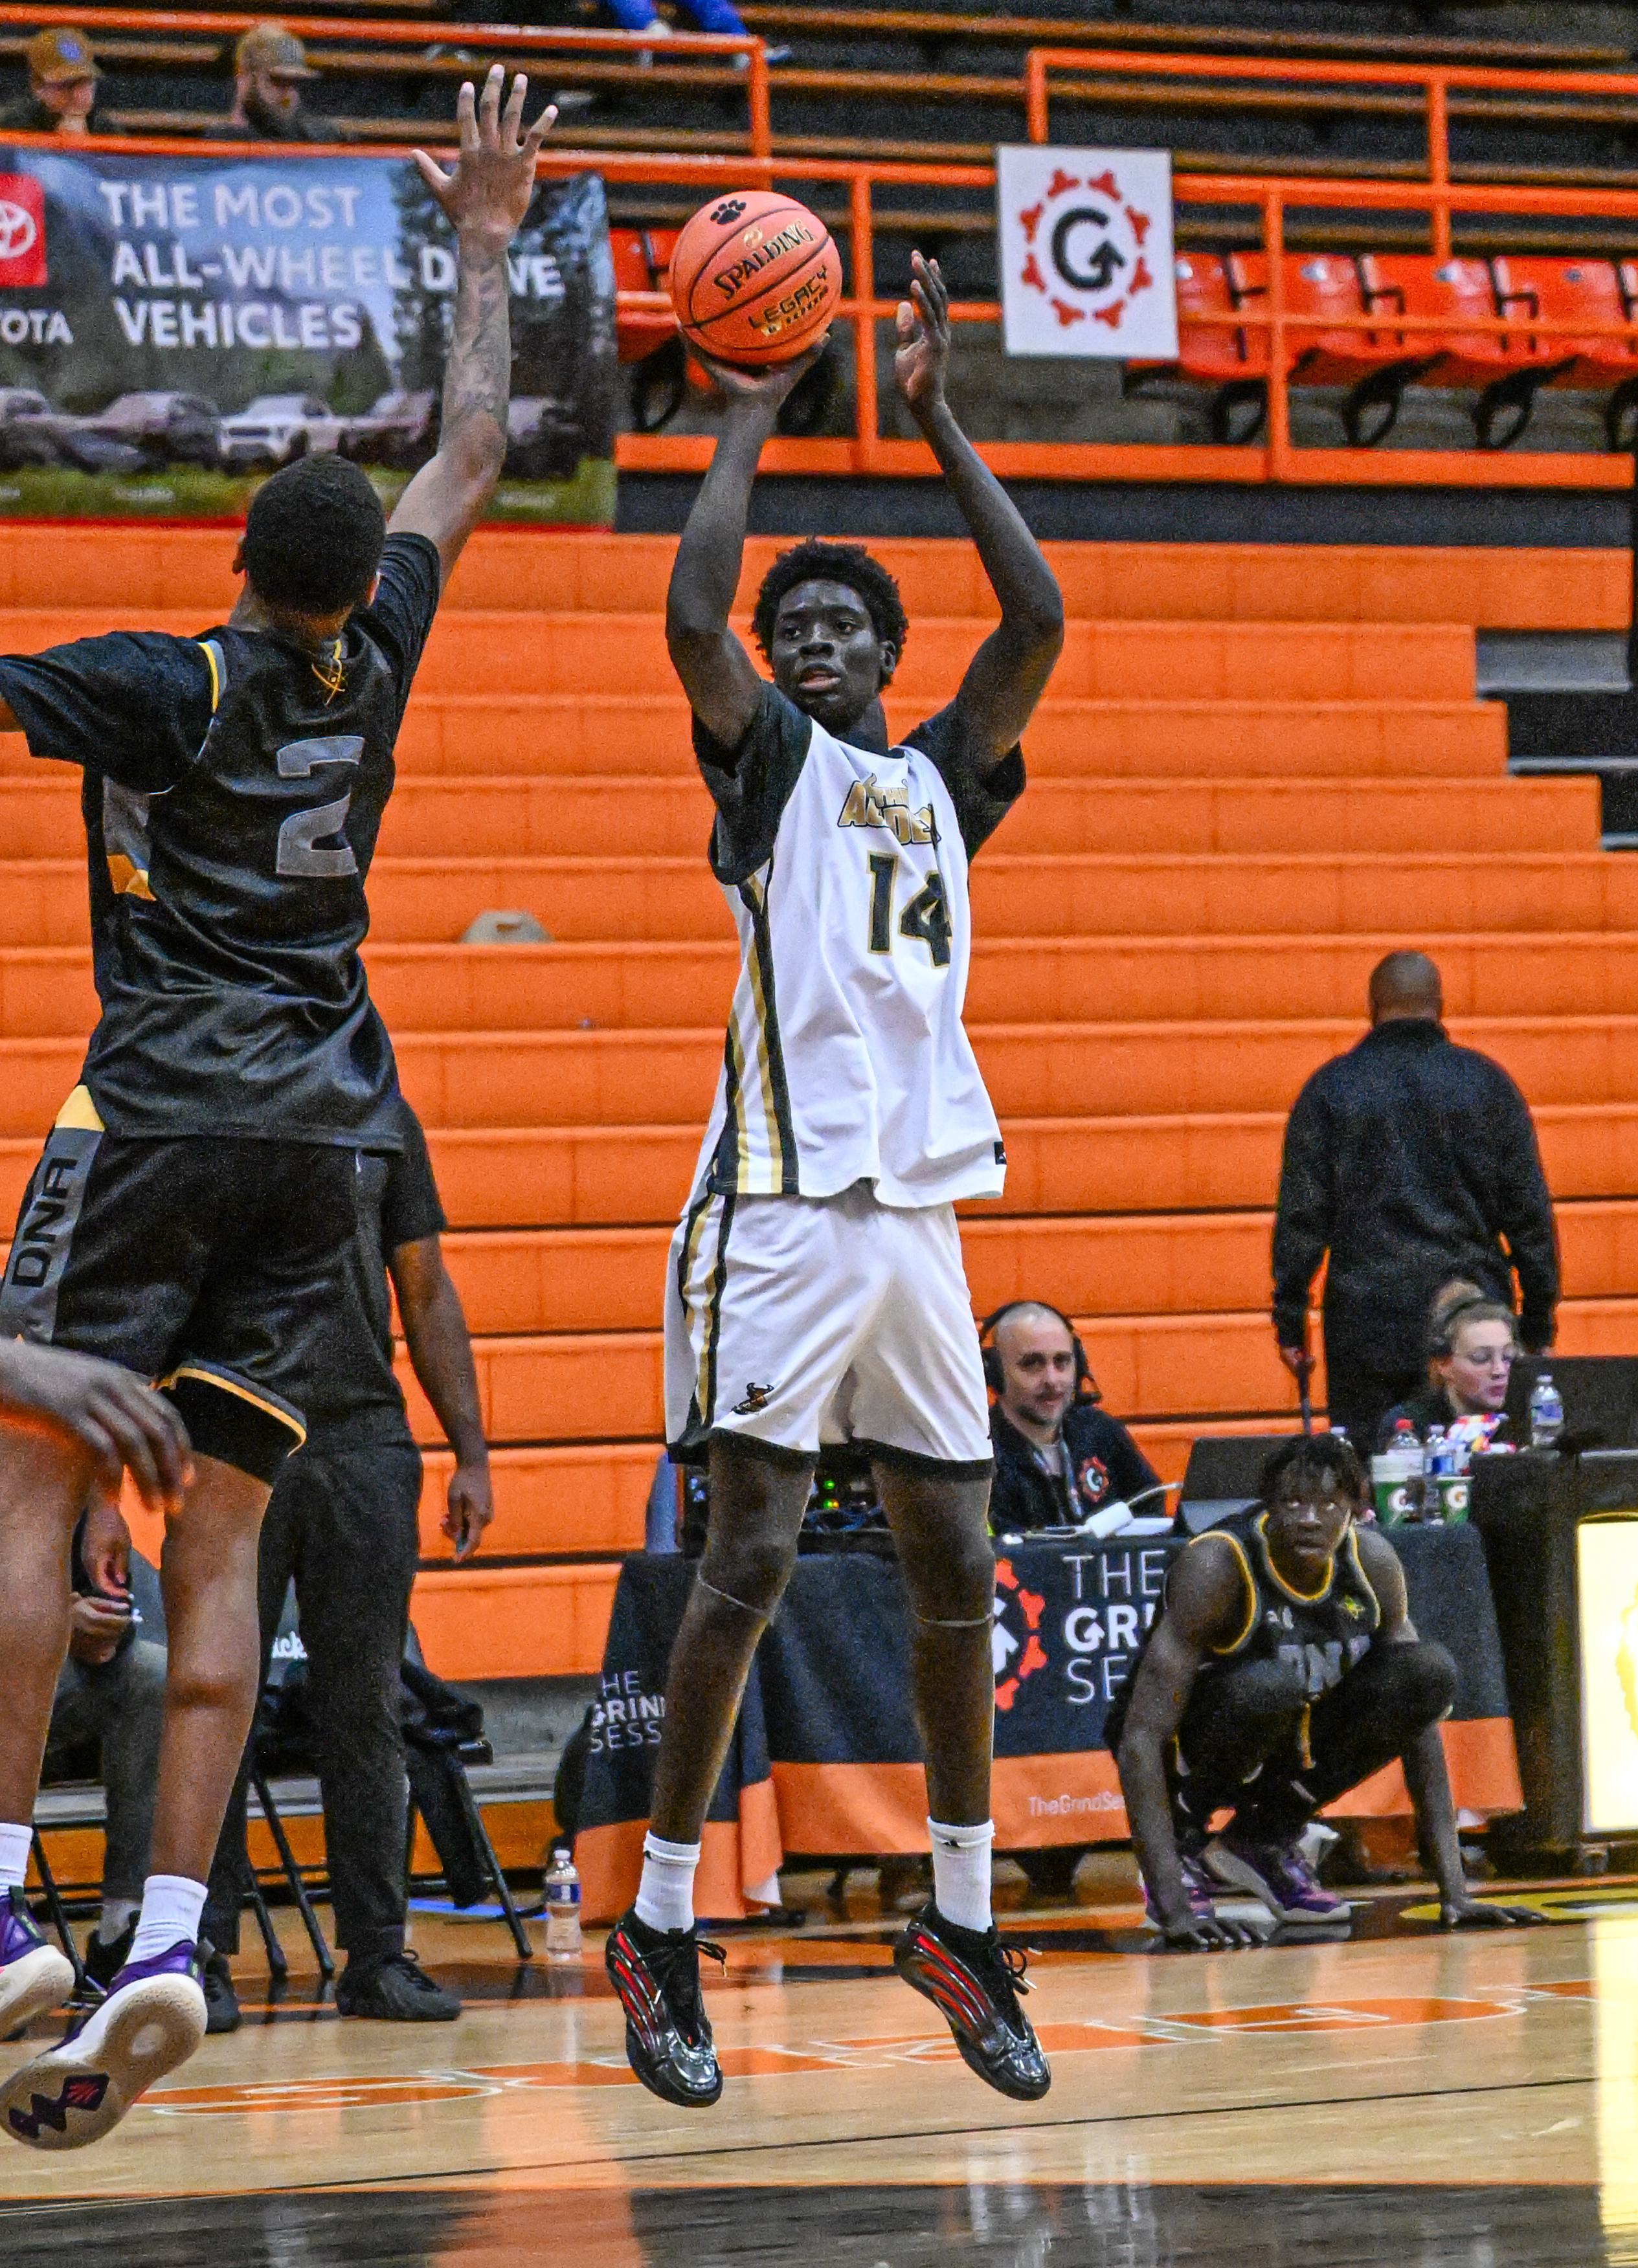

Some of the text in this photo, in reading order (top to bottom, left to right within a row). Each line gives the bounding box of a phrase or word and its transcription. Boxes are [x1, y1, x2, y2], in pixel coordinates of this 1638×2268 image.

[99, 181, 363, 230] THE MOST
[111, 240, 567, 300] ALL-WHEEL DVE
[713, 219, 816, 302] SPALDING
[0, 309, 74, 345] OTA
[112, 296, 363, 350] VEHICLES
[276, 735, 365, 878] 2
[866, 849, 954, 970] 14
[11, 1156, 79, 1288] DNA
[1062, 1549, 1166, 1599] THE
[601, 1669, 642, 1698] HE
[1067, 1654, 1129, 1704] SE
